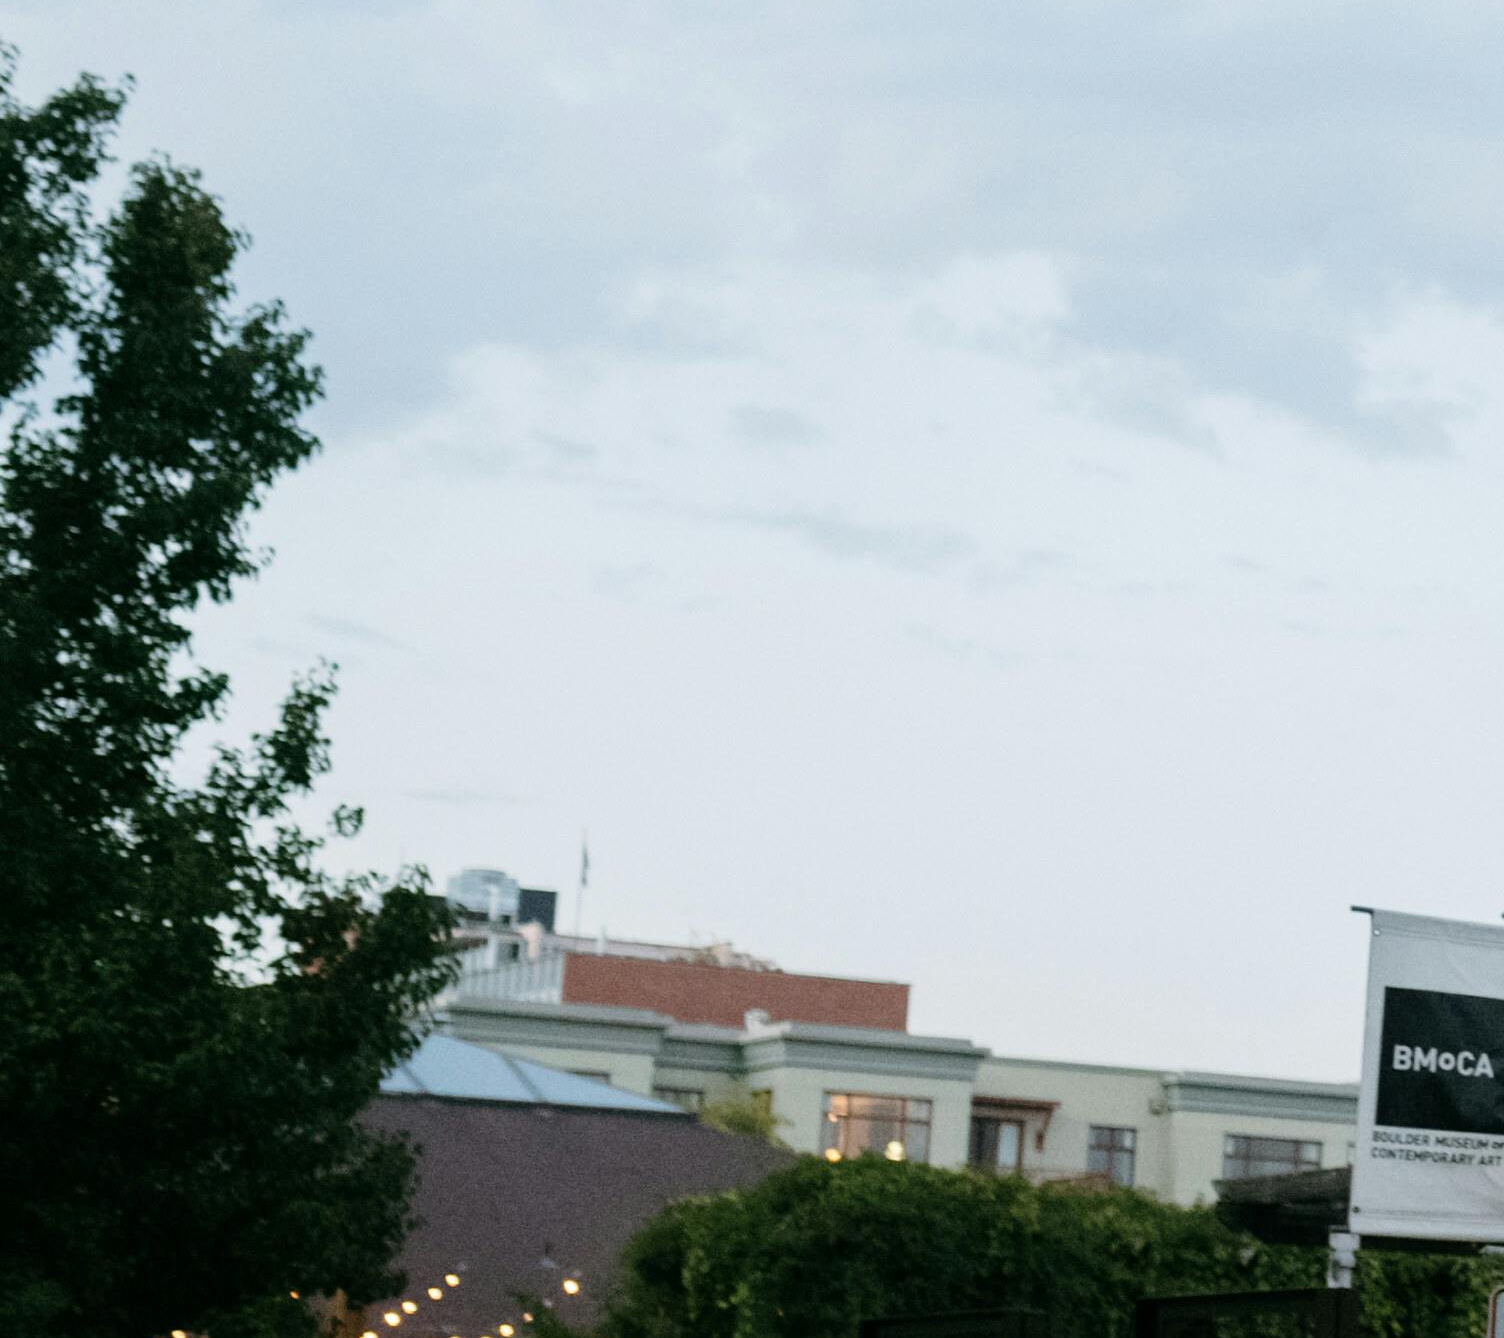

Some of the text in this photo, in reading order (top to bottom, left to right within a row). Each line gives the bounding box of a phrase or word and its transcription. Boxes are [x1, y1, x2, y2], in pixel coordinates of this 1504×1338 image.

[1372, 1130, 1429, 1145] BOULDER
[1434, 1136, 1488, 1148] MUSEUM
[1371, 1146, 1501, 1165] CONTEMPORARY ART
